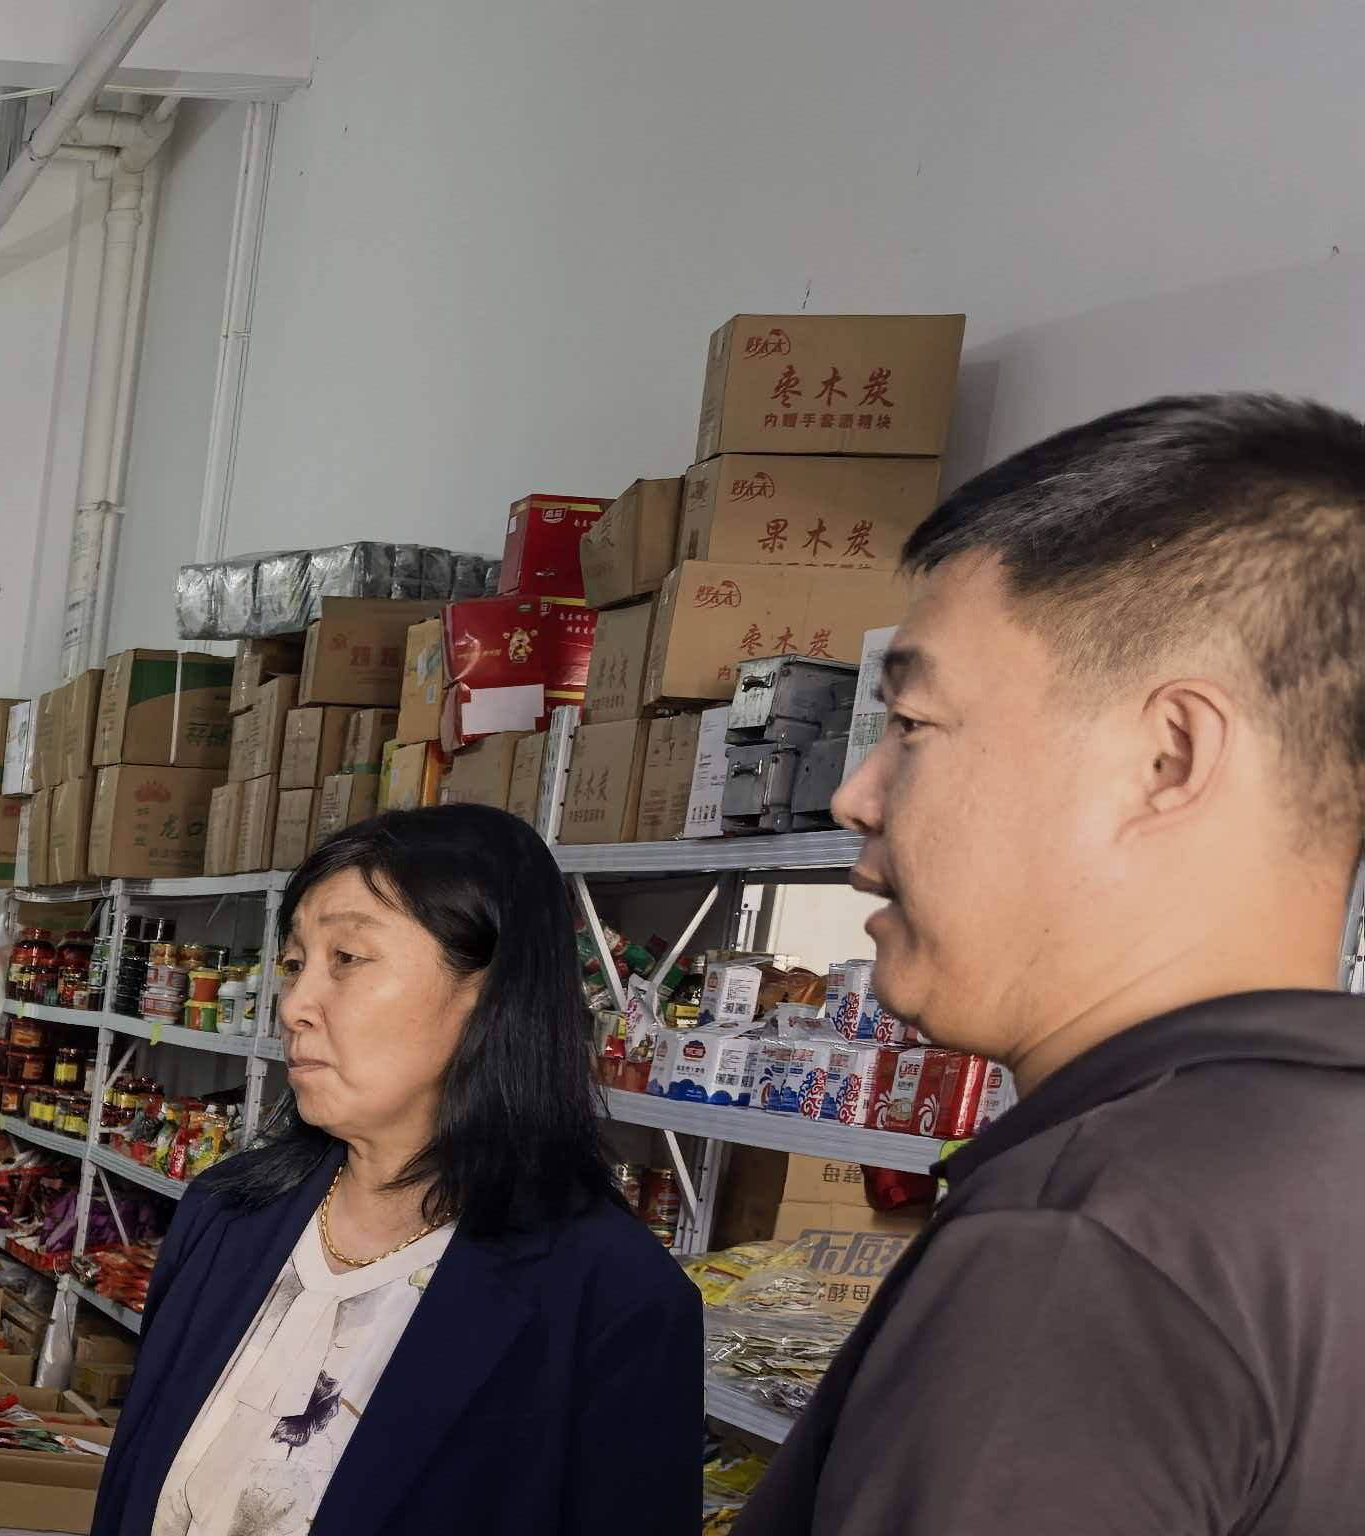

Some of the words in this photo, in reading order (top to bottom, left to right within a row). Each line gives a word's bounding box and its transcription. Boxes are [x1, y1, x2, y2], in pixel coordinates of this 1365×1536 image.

[757, 518, 876, 559] 果木炭
[741, 624, 835, 658] 枣木炭
